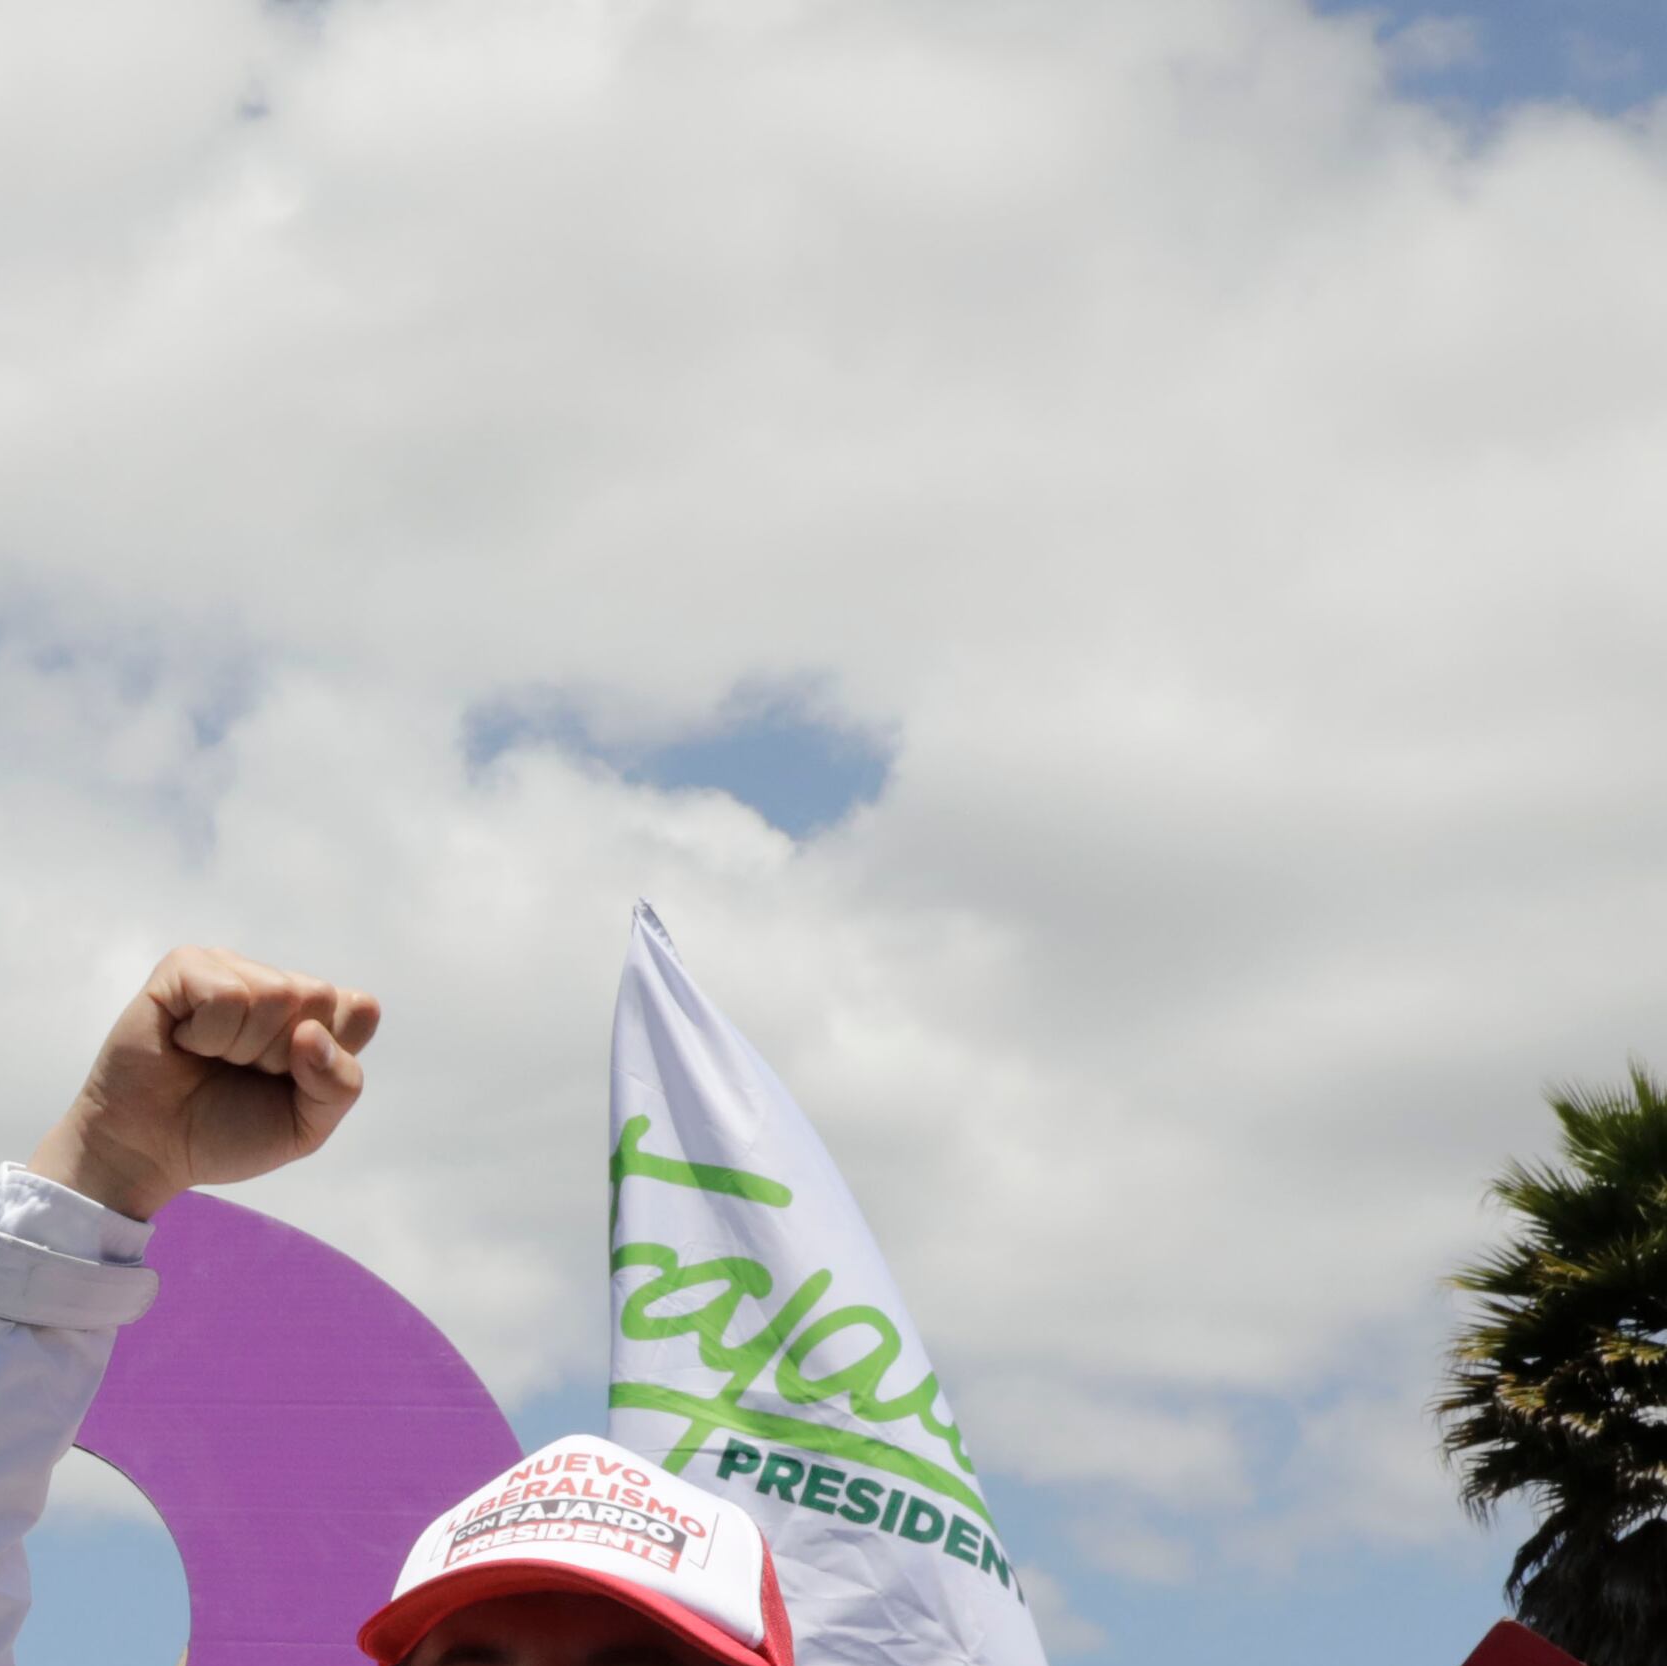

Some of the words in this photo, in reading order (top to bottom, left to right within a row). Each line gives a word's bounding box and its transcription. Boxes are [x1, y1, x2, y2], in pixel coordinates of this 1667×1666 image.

[506, 1452, 652, 1488] NUEVO
[447, 1477, 707, 1539] LIBERALISMO
[454, 1515, 497, 1543] CON
[497, 1500, 676, 1545] FAJARDO
[716, 1437, 1025, 1606] PRESIDEN
[448, 1522, 677, 1570] PRESIDENTE
